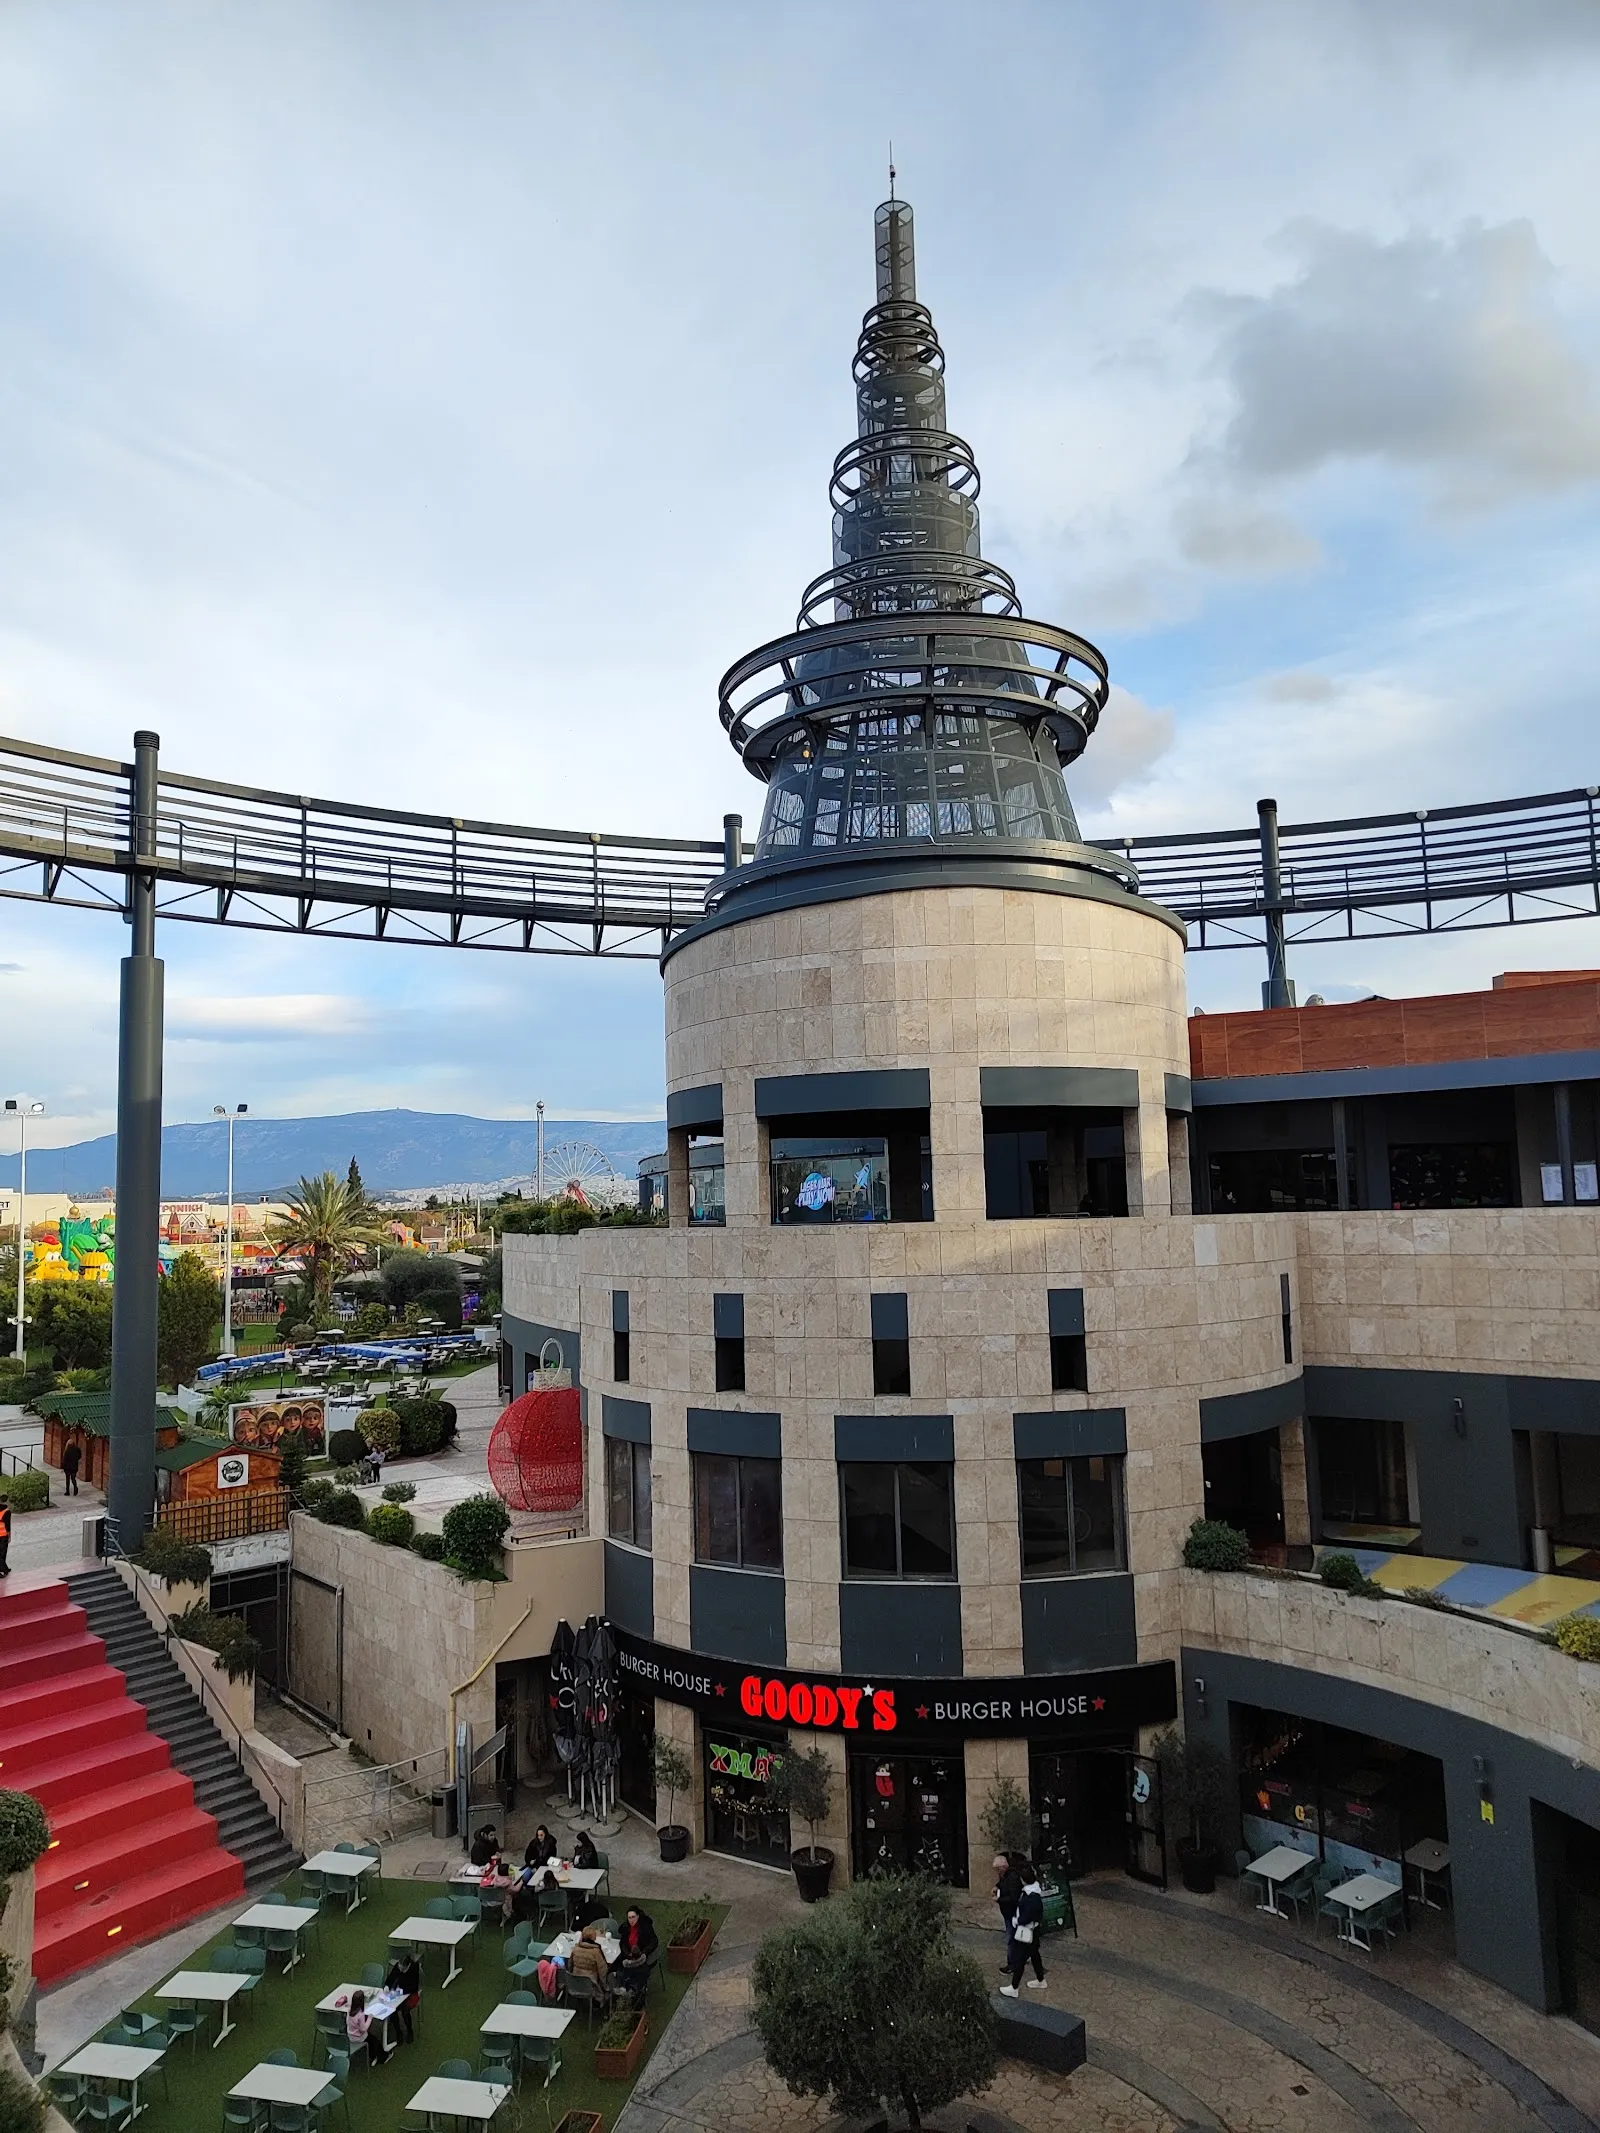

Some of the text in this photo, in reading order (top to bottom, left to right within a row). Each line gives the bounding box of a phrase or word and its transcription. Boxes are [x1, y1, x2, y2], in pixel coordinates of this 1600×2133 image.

[161, 1204, 203, 1213] ΡΟΝΙΚΗ
[619, 1651, 711, 1696] BURGER HOUSE
[935, 1695, 1088, 1720] BURGER HOUSE
[710, 1743, 780, 1783] XMA
